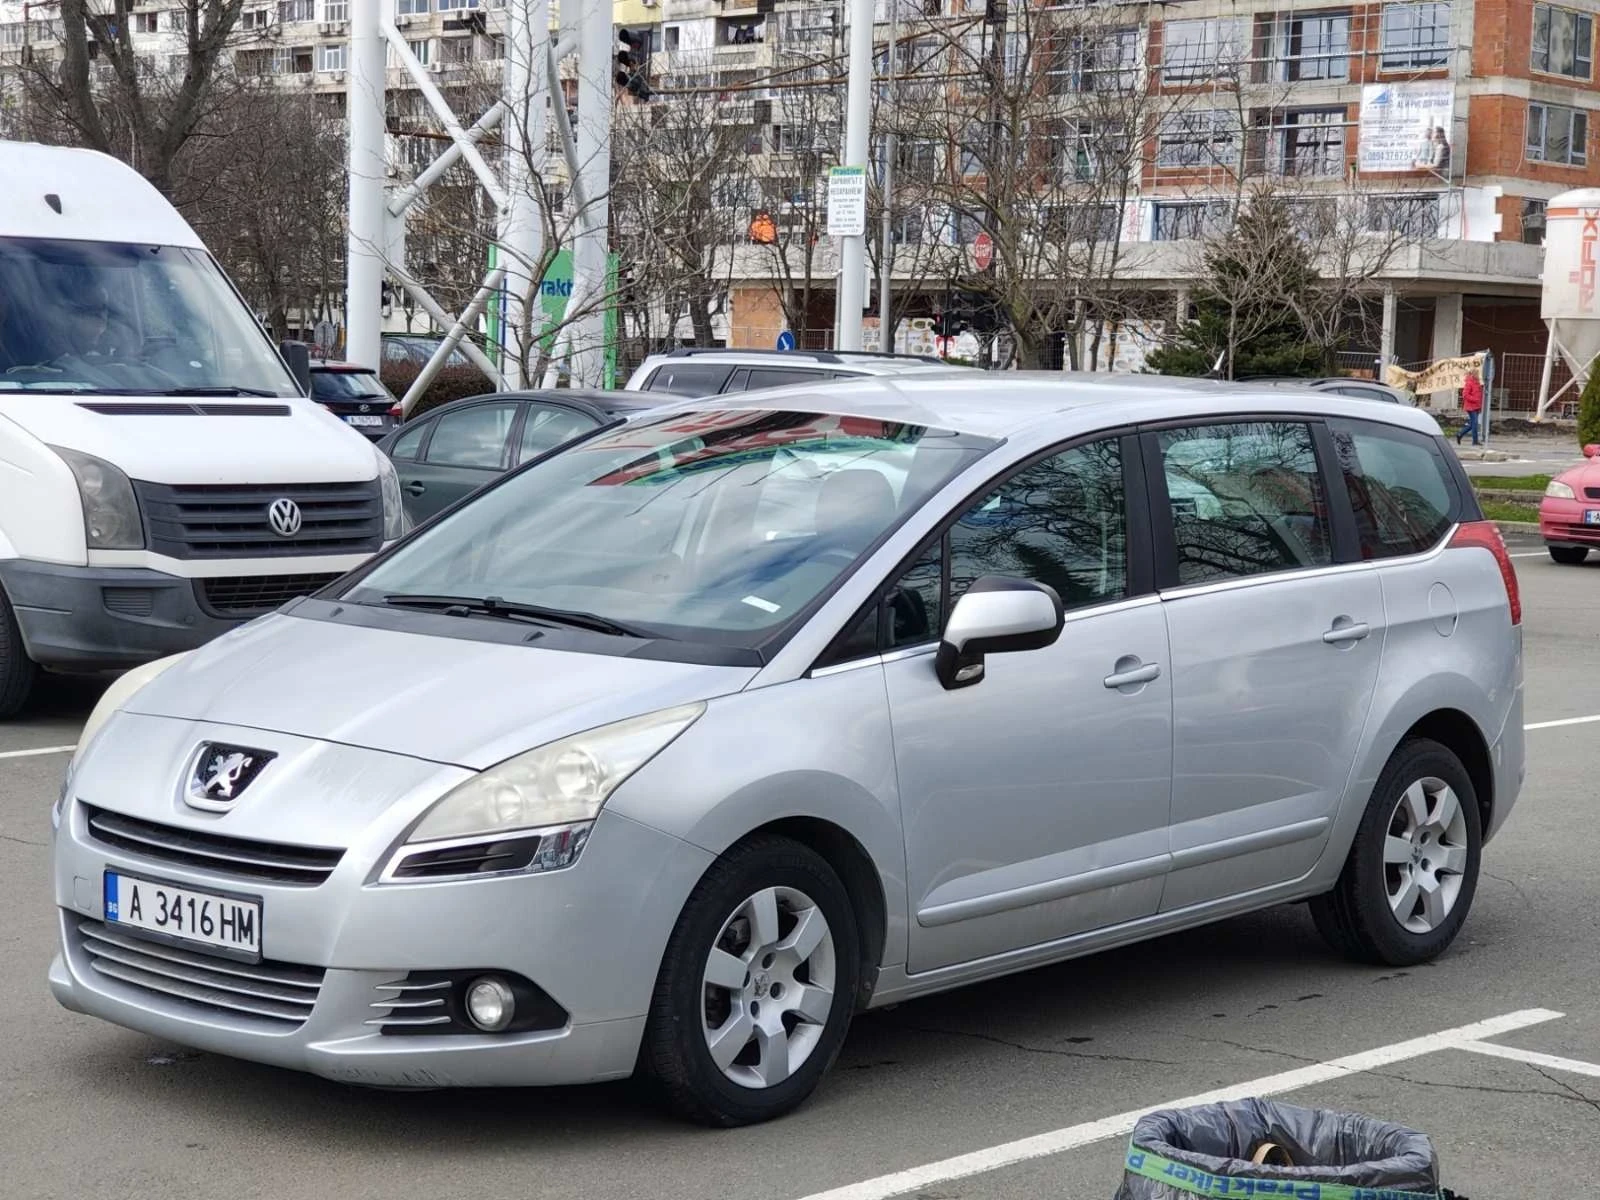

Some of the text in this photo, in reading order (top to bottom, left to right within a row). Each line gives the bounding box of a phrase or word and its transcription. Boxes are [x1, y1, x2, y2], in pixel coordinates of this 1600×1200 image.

[541, 278, 574, 297] rakt
[130, 885, 142, 921] A
[1163, 1163, 1321, 1200] Praktiker
